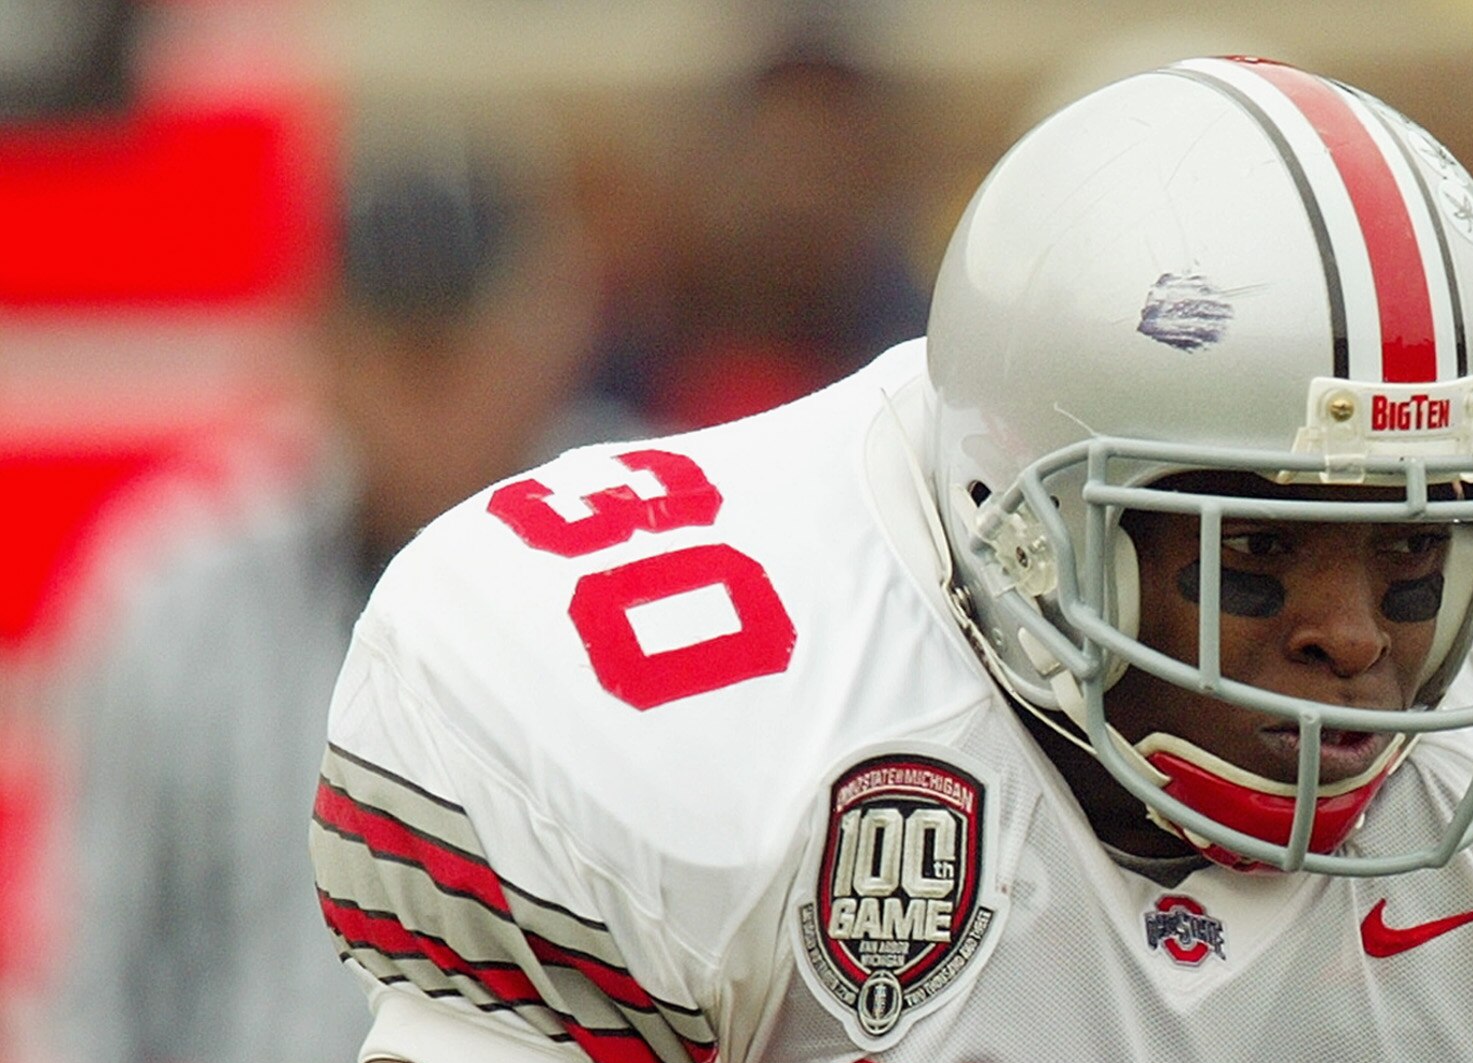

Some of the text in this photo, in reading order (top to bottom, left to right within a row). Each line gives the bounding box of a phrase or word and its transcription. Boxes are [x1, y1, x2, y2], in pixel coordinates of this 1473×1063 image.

[486, 448, 798, 712] 30
[904, 768, 974, 814] MICHIGAN
[828, 897, 954, 943] GAME
